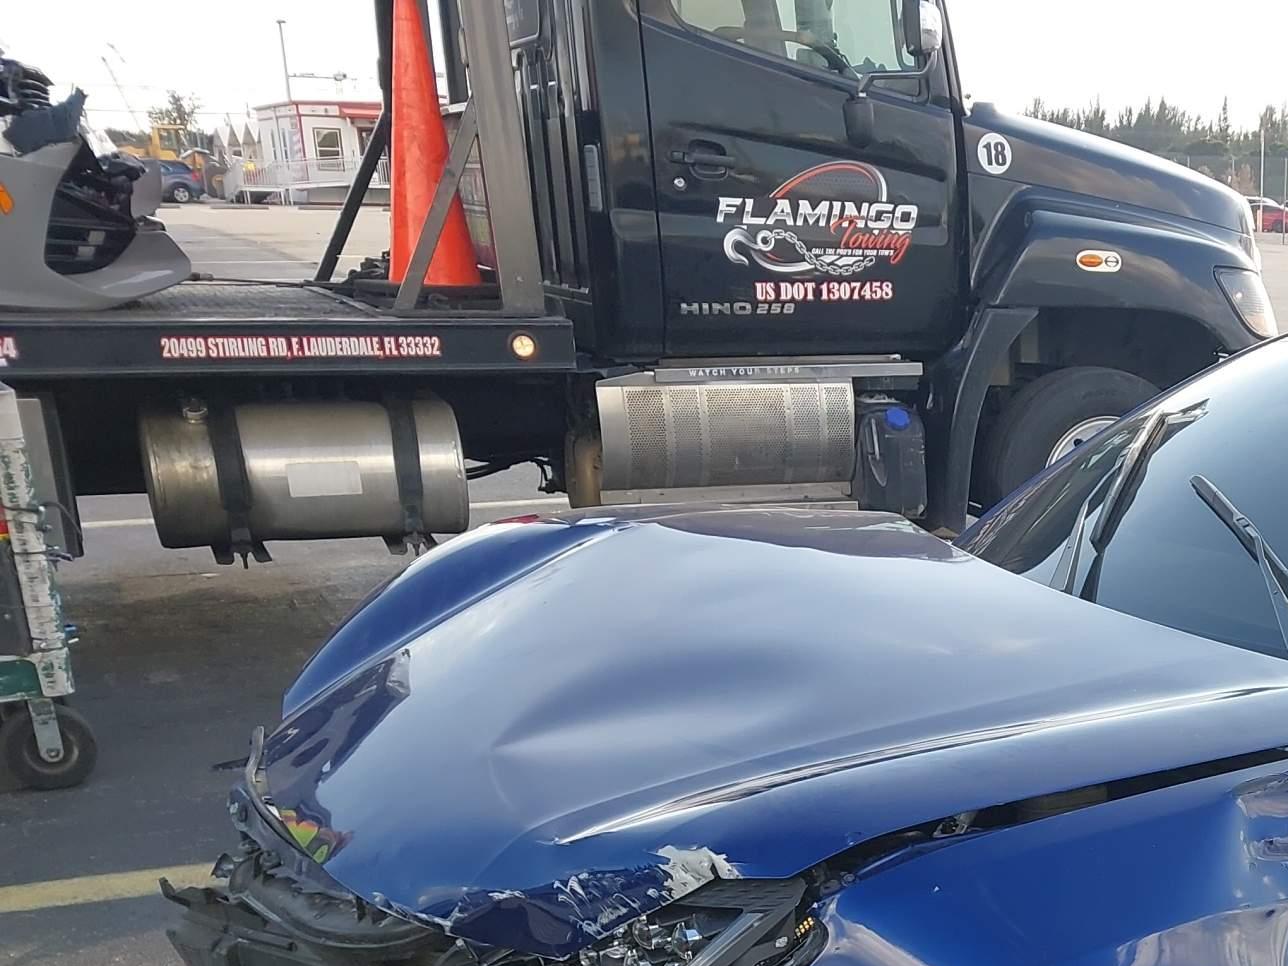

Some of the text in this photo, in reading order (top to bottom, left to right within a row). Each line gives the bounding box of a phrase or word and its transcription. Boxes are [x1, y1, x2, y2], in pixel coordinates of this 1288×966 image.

[982, 141, 1007, 167] 18
[715, 196, 919, 230] FLAMINGO
[829, 215, 914, 265] Towing
[755, 280, 894, 301] US DOT 1307458
[680, 301, 796, 316] HINO 258
[160, 337, 206, 358] 20499
[207, 337, 267, 358] STIRLING
[384, 336, 398, 357] FL
[398, 336, 442, 357] 33332
[688, 367, 726, 377] WATCH
